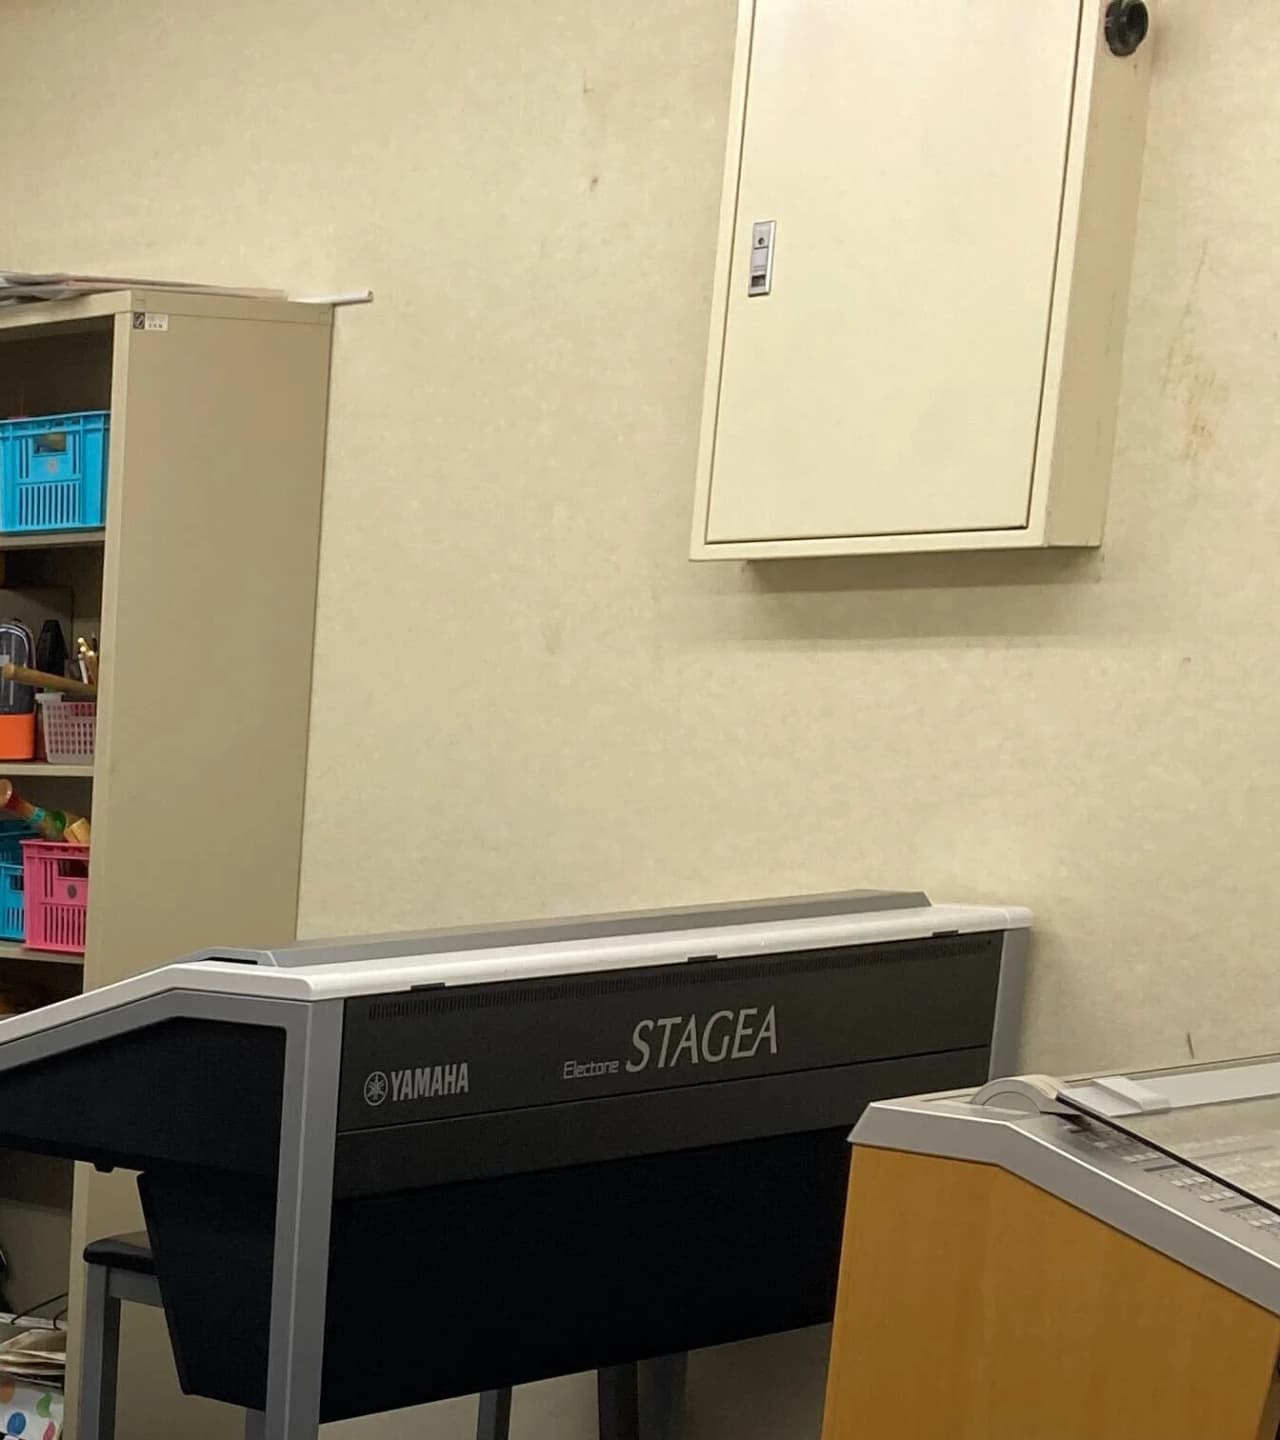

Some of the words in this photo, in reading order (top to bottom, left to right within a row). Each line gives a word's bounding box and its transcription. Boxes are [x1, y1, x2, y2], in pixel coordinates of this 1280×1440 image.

[563, 1060, 620, 1080] Electone
[625, 1004, 778, 1073] STAGEA
[390, 1062, 470, 1101] YAMAHA
